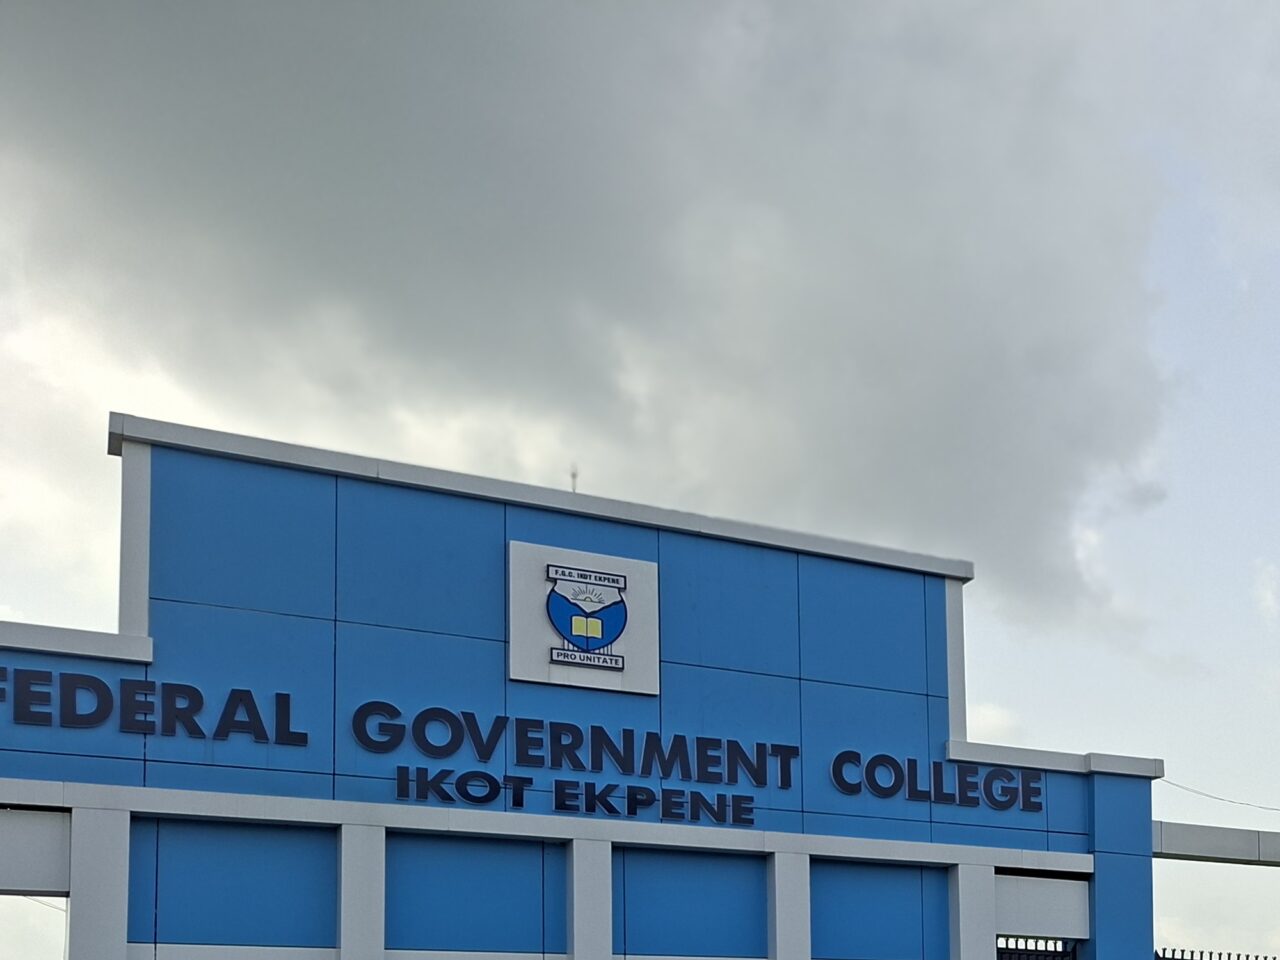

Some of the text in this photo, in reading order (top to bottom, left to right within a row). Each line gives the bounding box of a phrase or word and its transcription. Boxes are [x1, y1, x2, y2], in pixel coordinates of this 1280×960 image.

[594, 575, 620, 584] EKPENE
[556, 652, 620, 666] PRO UNITATE
[0, 666, 1043, 811] EDERAL GOVERNMENT COLLEGE
[396, 765, 755, 826] IKOT EKPENE
